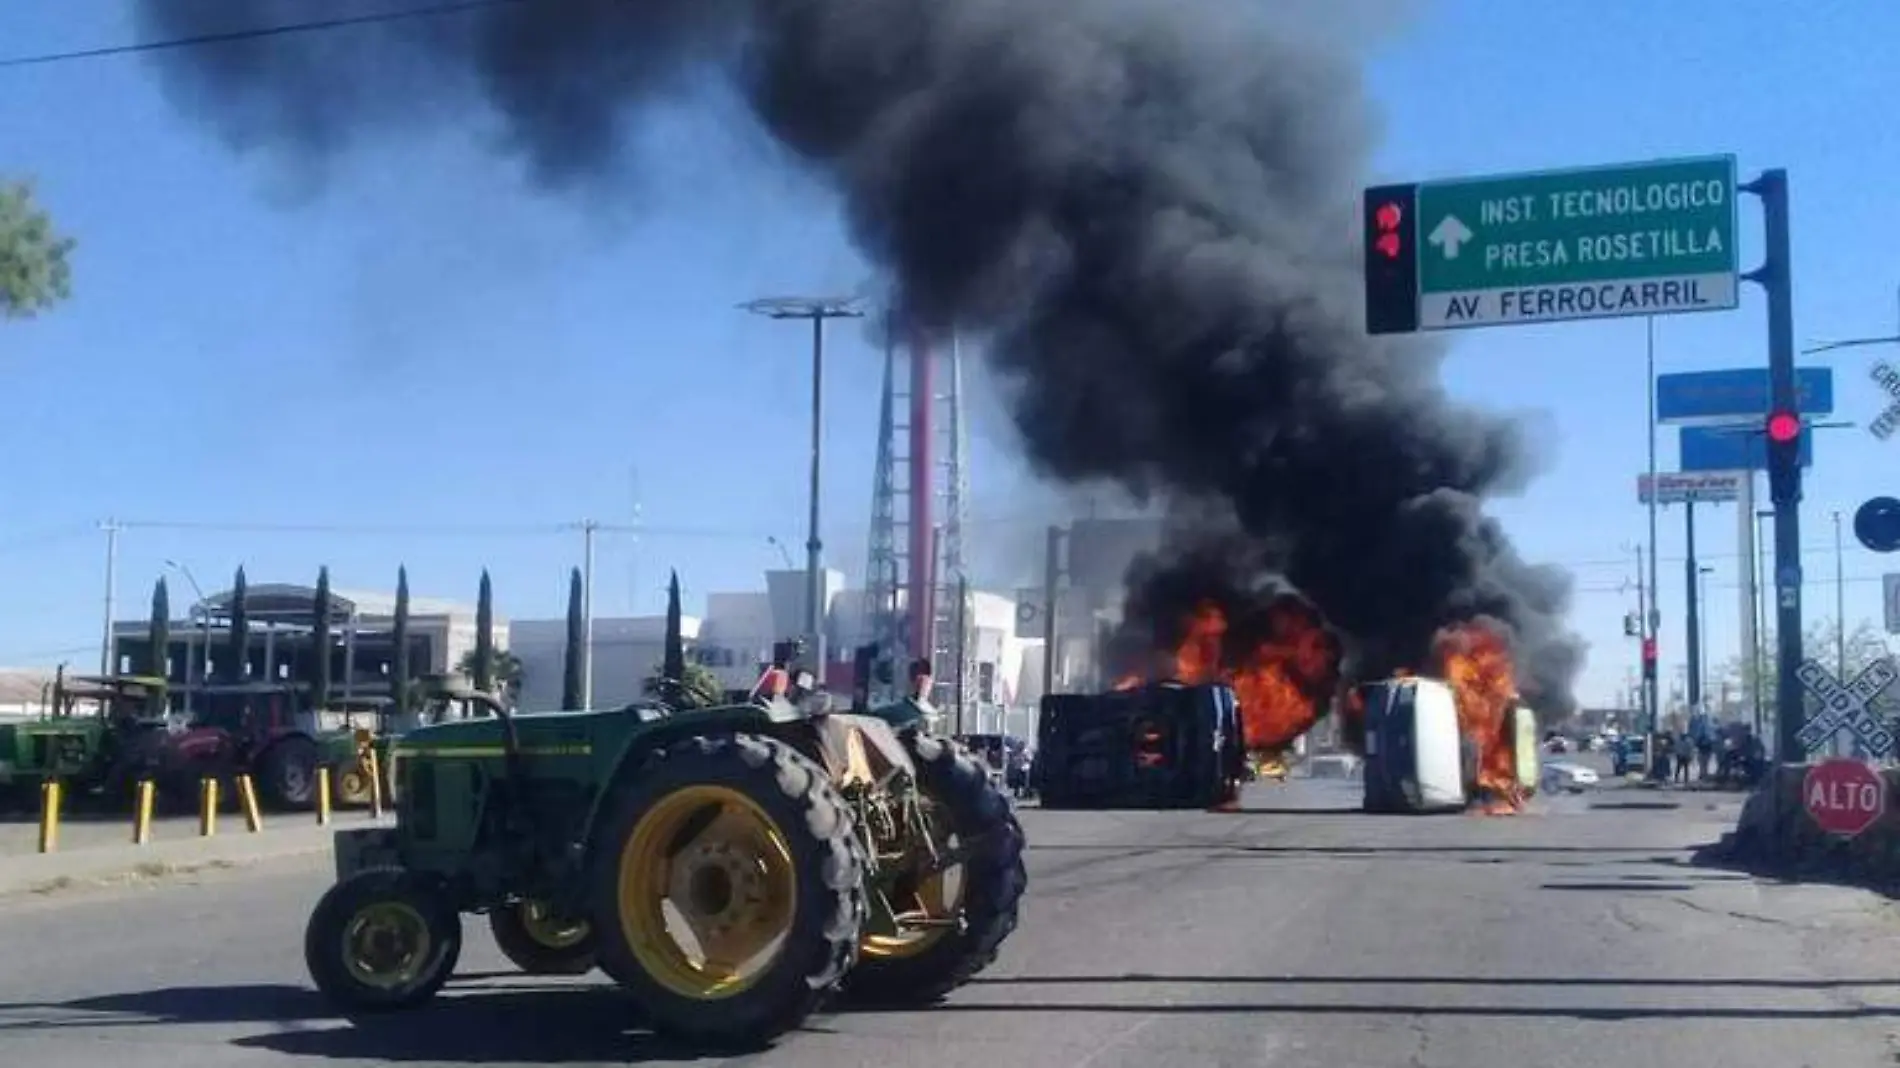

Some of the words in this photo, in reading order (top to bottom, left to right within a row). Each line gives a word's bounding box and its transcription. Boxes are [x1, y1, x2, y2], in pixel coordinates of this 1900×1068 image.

[1548, 179, 1723, 218] TECNOLOGICO
[1485, 238, 1569, 270] PRESA
[1577, 227, 1723, 261] ROSETILLA
[1500, 279, 1707, 317] FERROCARRIL
[1800, 664, 1889, 749] CUIDADO
[1810, 781, 1877, 811] ALTO
